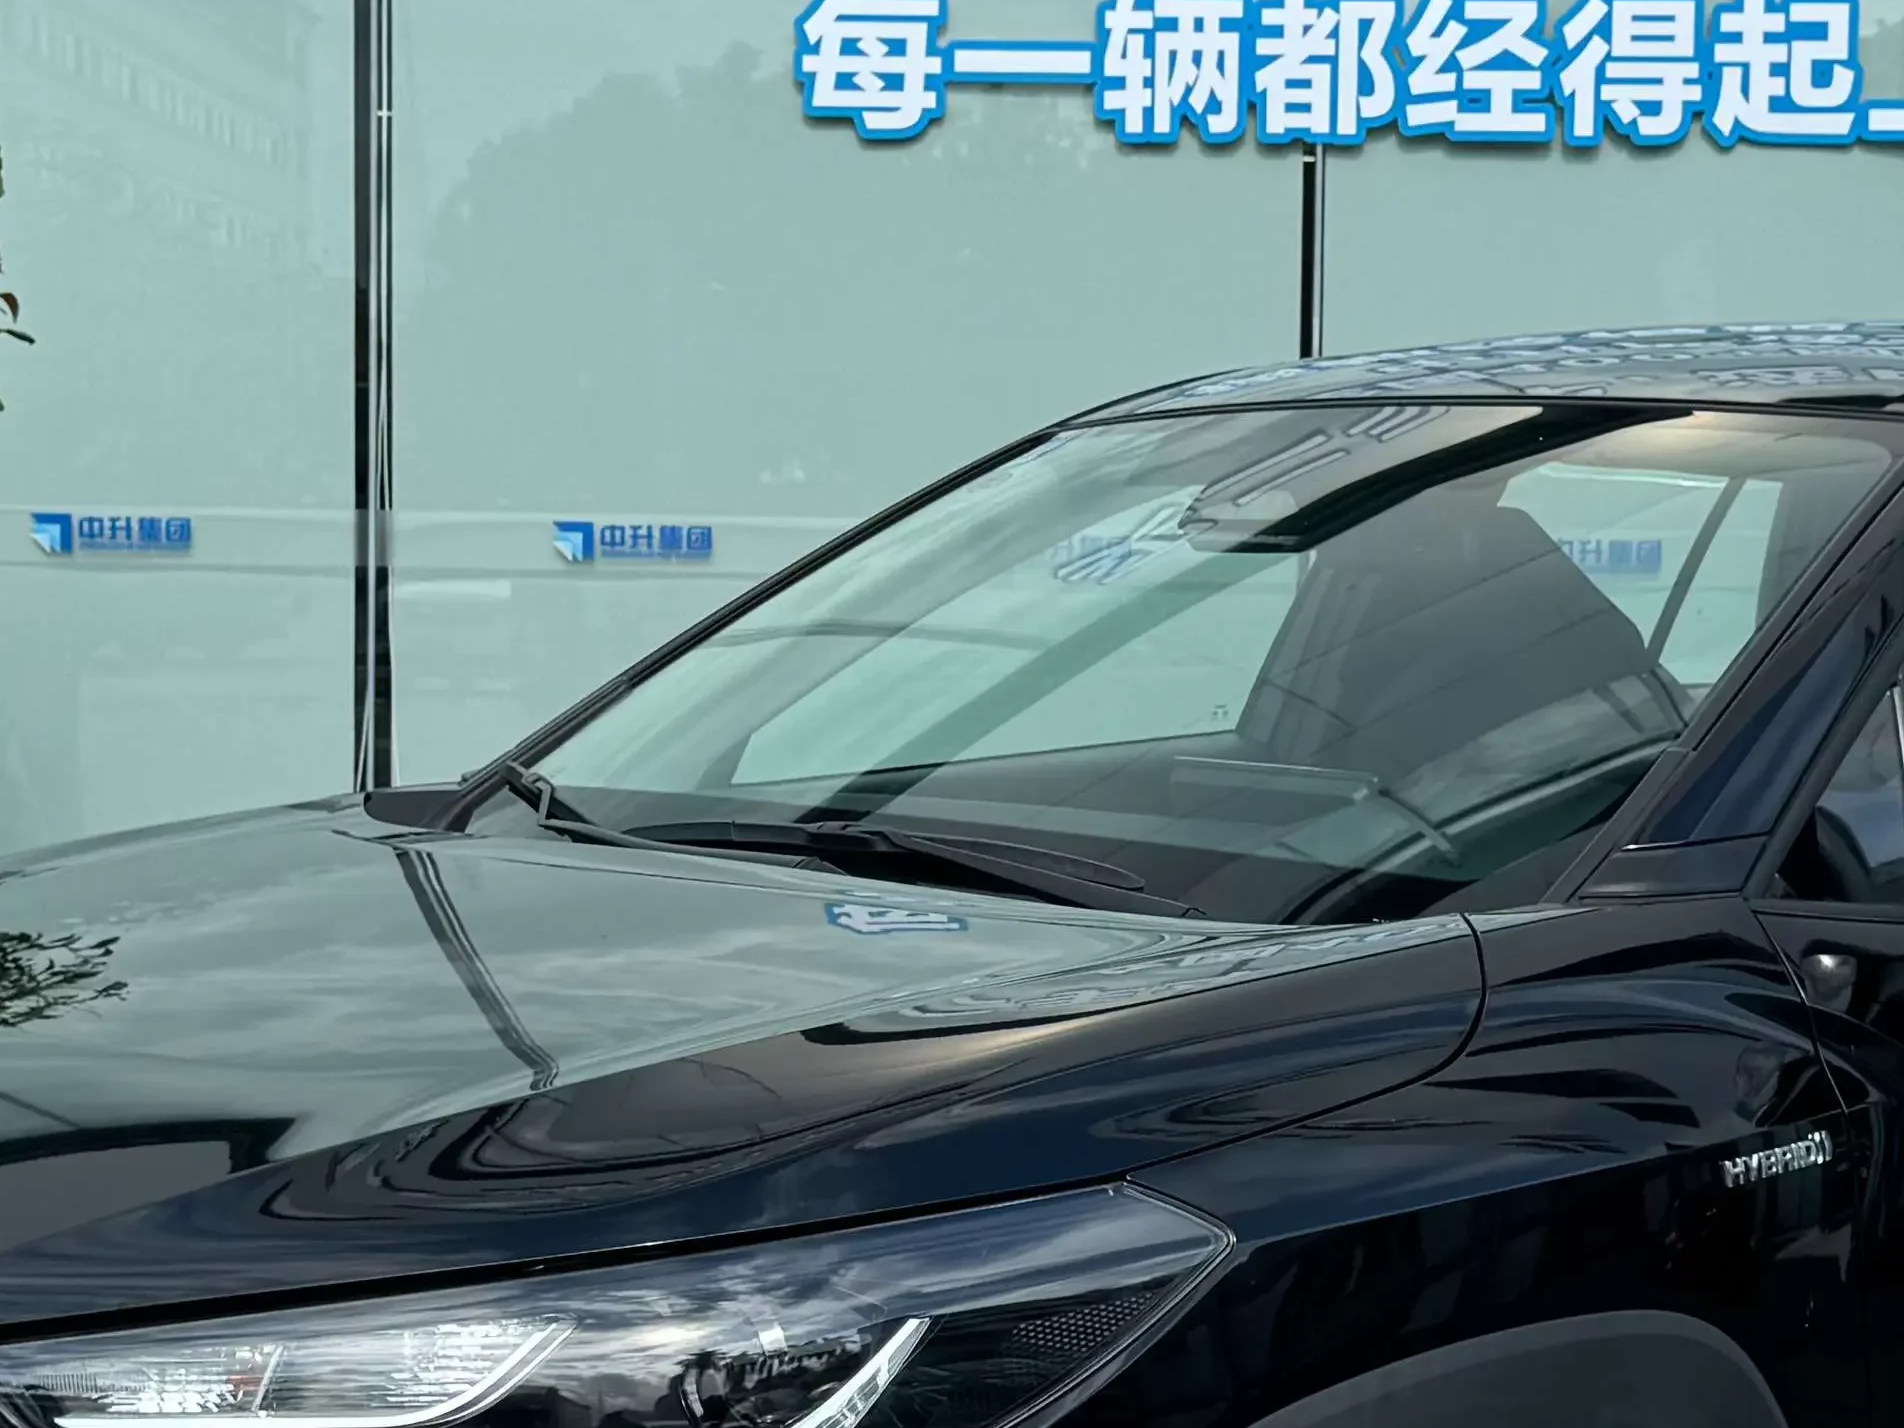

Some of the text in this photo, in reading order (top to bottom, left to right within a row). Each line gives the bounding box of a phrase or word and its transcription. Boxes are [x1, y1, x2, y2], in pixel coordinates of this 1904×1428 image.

[79, 516, 191, 542] 中升集团
[600, 525, 712, 549] 中升集团
[1722, 1140, 1816, 1188] HYBRID
